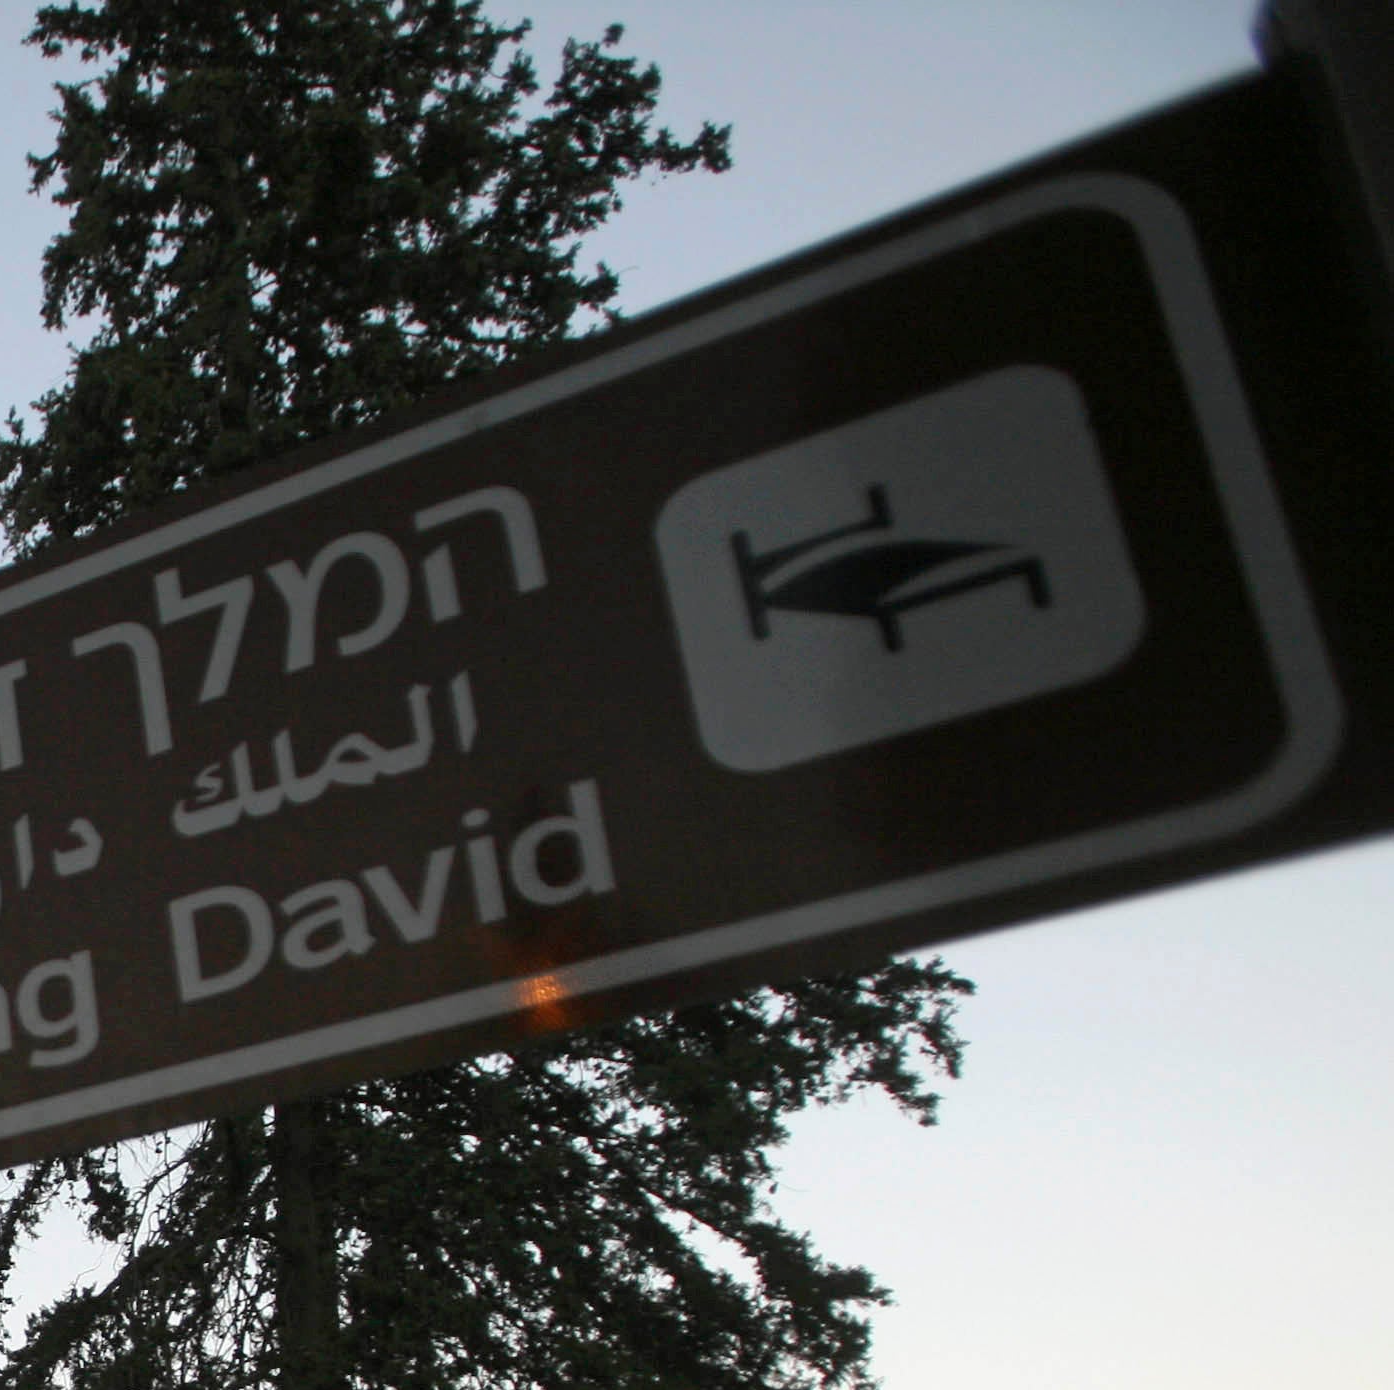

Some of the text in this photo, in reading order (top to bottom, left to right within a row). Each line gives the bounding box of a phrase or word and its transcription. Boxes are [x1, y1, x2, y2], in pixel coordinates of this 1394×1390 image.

[73, 487, 545, 756] המלך
[171, 672, 476, 838] الملك
[168, 780, 614, 1003] David
